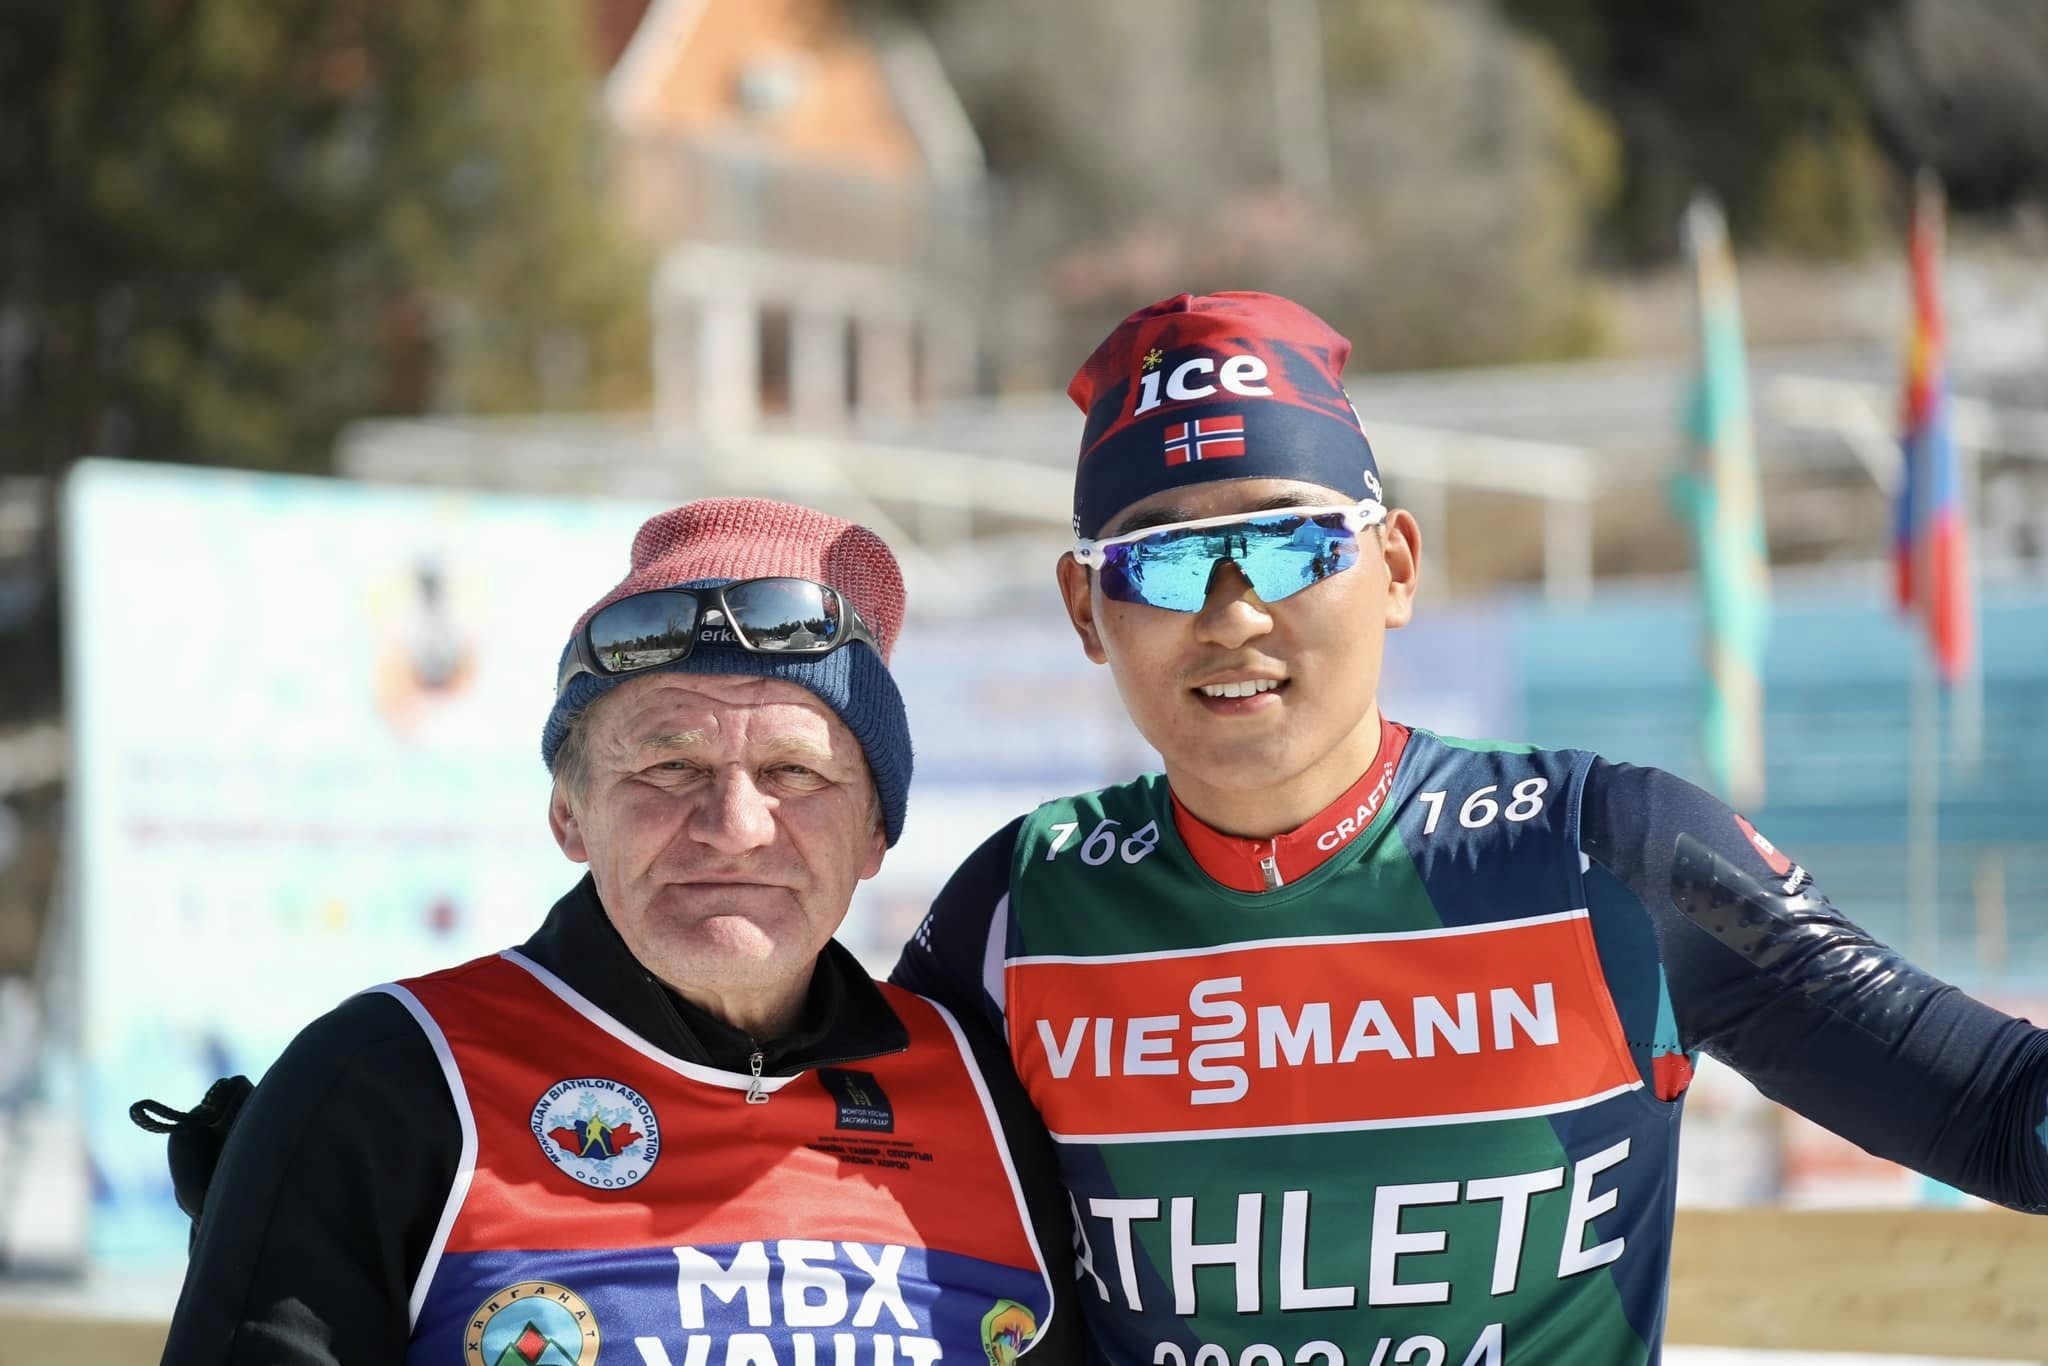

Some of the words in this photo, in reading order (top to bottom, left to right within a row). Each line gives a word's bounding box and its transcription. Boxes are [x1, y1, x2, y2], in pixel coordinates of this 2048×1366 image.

[1134, 348, 1274, 416] ice
[1316, 774, 1388, 851] CRAFT
[1418, 777, 1549, 835] 168
[1045, 818, 1161, 866] 168
[1035, 975, 1560, 1106] VIESSMANN
[532, 1099, 561, 1163] MONGOLIAN
[548, 1079, 615, 1101] BIATHLON
[616, 1087, 658, 1163] ASSOCIATION
[841, 1107, 867, 1117] МОНГОЛ
[869, 1118, 889, 1126] ГАЗАР
[672, 1240, 920, 1330] МБХ
